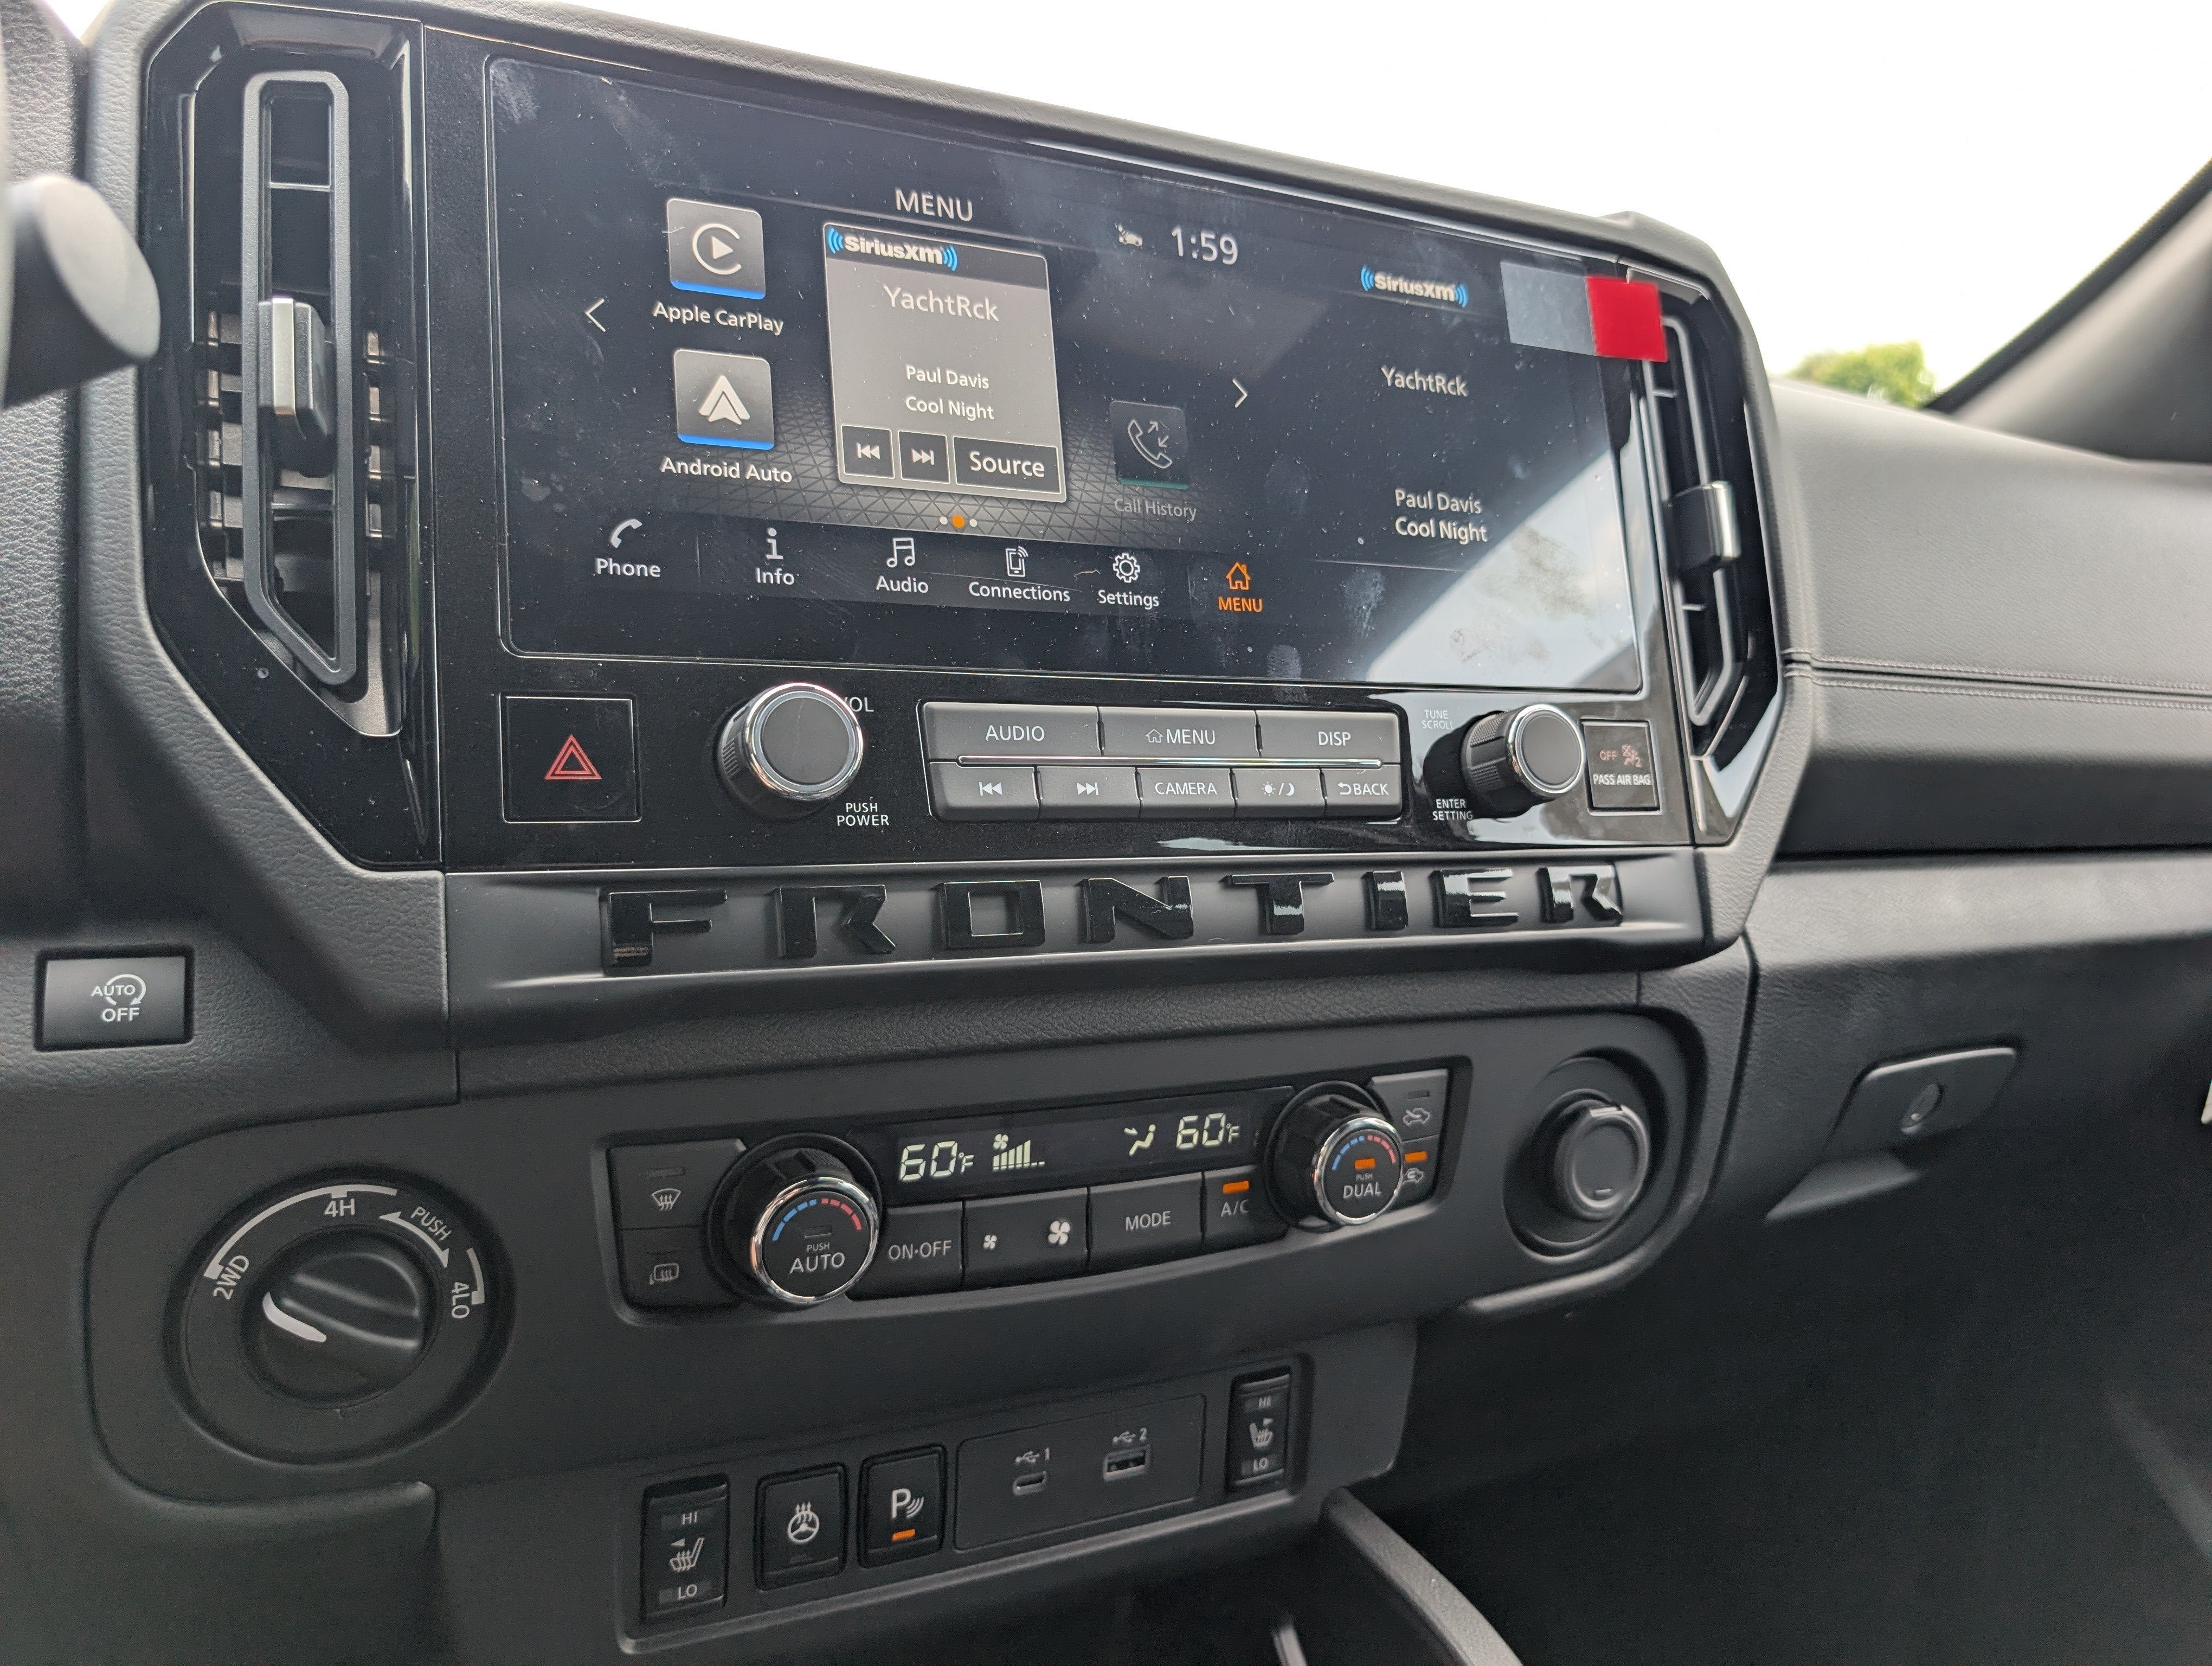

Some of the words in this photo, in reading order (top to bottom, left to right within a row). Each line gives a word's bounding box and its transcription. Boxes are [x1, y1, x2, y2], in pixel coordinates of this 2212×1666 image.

[896, 189, 973, 221] MENU
[1171, 226, 1238, 265] 1:59
[884, 285, 999, 322] YachtRck
[653, 302, 711, 324] Apple
[716, 310, 784, 336] CarPlay
[906, 364, 941, 384] Paul
[947, 370, 989, 389] Davis
[1381, 366, 1468, 396] YachtRck
[906, 395, 943, 416] Cool
[949, 399, 994, 422] Night
[661, 456, 741, 479] Android
[746, 464, 792, 483] Auto
[969, 451, 1045, 478] Source
[1114, 498, 1142, 514] Call
[1145, 501, 1197, 521] History
[1395, 489, 1433, 510] Paul
[1437, 493, 1482, 515] Davis
[1395, 517, 1436, 539] Cool
[1439, 520, 1488, 544] Night
[596, 558, 661, 578] Phone
[756, 568, 795, 586] Info
[876, 575, 929, 594] Audio
[968, 581, 1070, 603] Connections
[1098, 589, 1159, 610] Settings
[1218, 597, 1263, 613] MENU
[1424, 710, 1448, 719] TUNE
[985, 725, 1045, 742] AUDIO
[1422, 720, 1454, 729] SCROLL
[1167, 729, 1216, 745] MENU
[1317, 731, 1351, 746] DISP
[1599, 750, 1617, 760] OFF
[1155, 782, 1217, 796] CAMERA
[1593, 774, 1615, 785] PASS
[1616, 774, 1631, 785] AIR
[1633, 774, 1651, 786] BAG
[1354, 783, 1389, 796] BACK
[845, 803, 878, 812] PUSH
[1436, 798, 1467, 809] ENTER
[836, 815, 889, 826] POWER
[1432, 810, 1474, 821] SETTING
[600, 866, 1624, 968] FRONTIER
[91, 984, 136, 997] AUTO
[102, 1007, 140, 1022] OFF
[1343, 1184, 1381, 1199] DUAL
[324, 1199, 355, 1217] 4H
[1221, 1200, 1248, 1218] A/C
[410, 1206, 452, 1240] PUSH
[1126, 1210, 1172, 1231] MODE
[806, 1242, 830, 1252] PUSH
[789, 1253, 845, 1274] AUTO
[213, 1254, 249, 1300] 2WD
[452, 1281, 470, 1318] 4LO
[1253, 1458, 1268, 1473] LO
[682, 1512, 697, 1524] HI
[678, 1584, 697, 1599] LO
